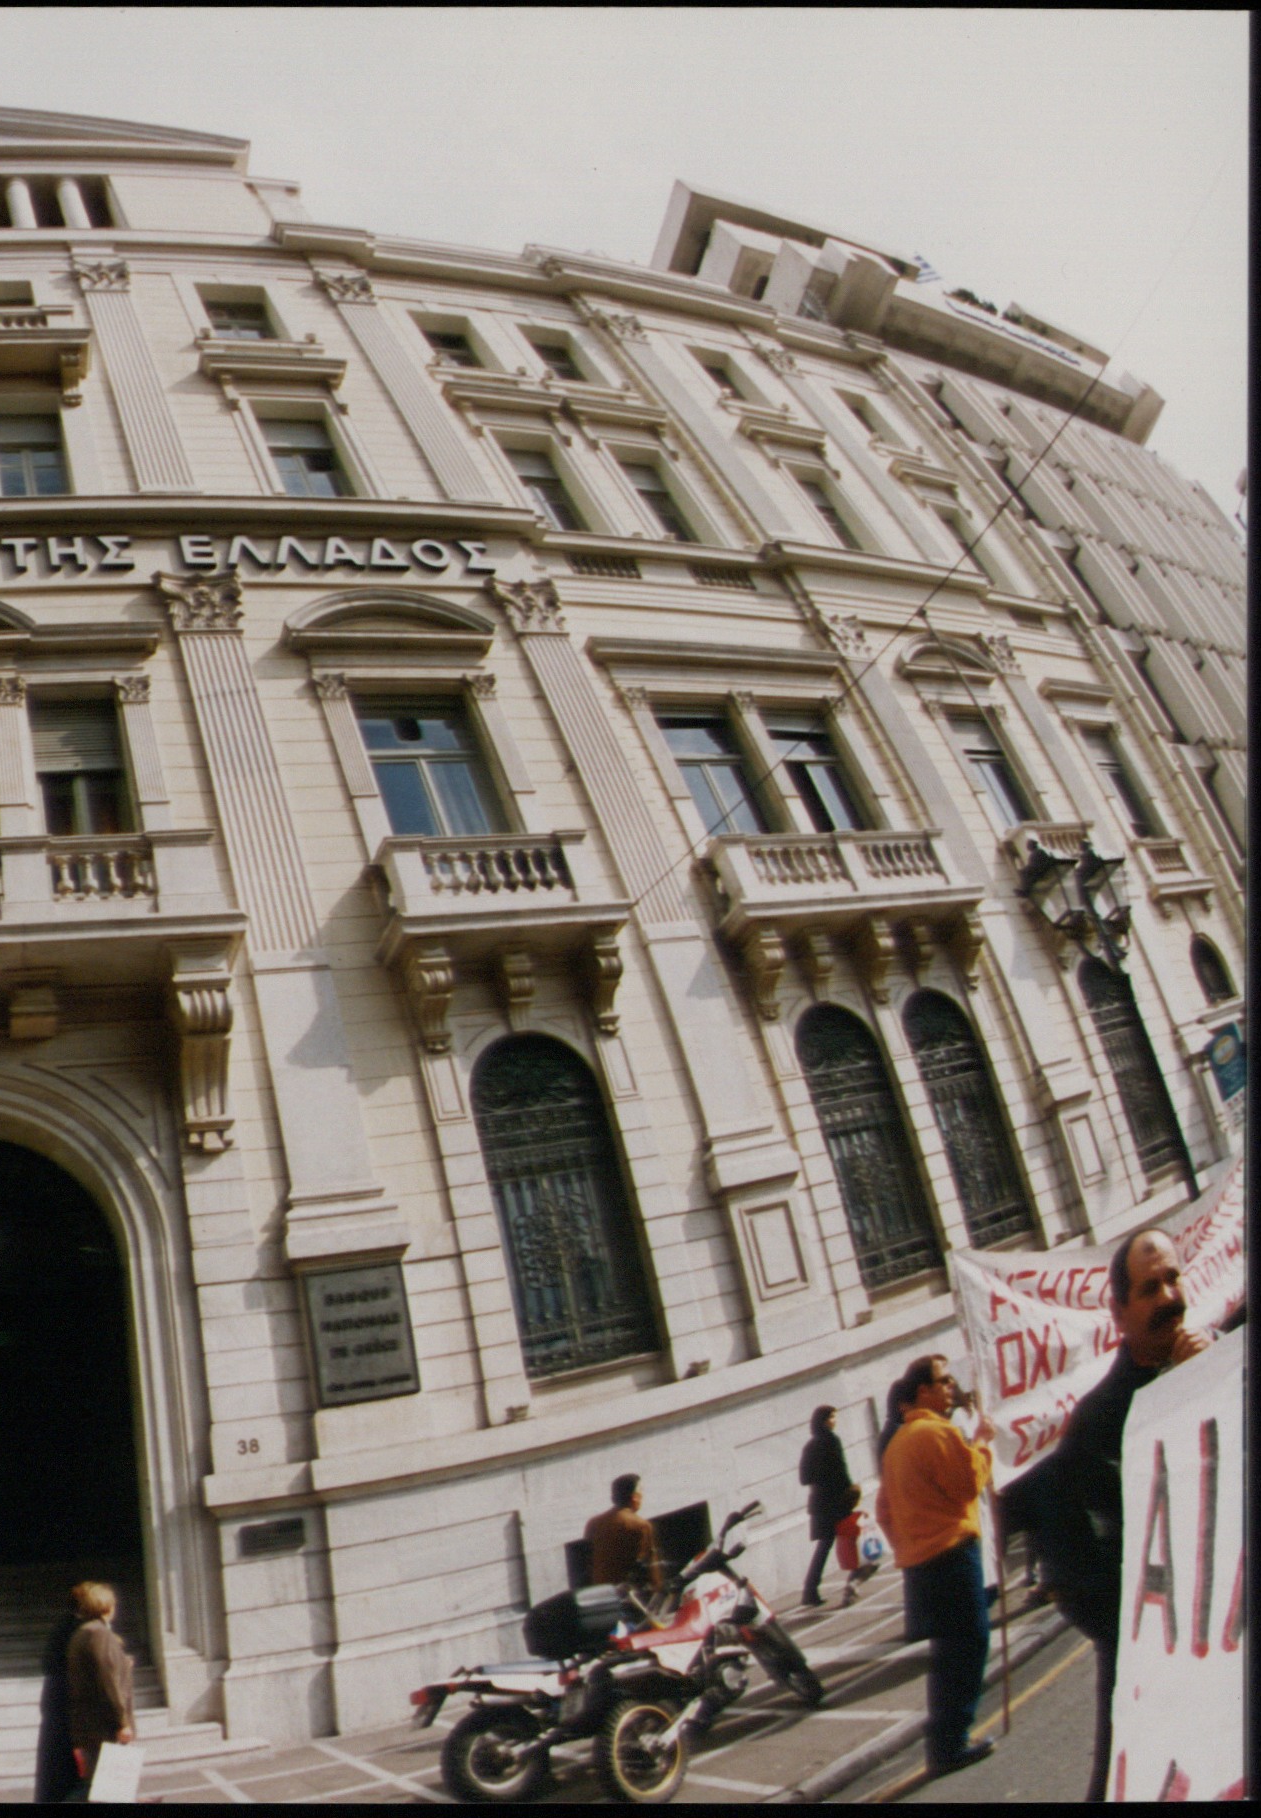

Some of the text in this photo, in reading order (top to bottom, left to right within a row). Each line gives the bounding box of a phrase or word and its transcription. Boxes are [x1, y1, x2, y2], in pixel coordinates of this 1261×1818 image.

[1, 535, 136, 575] ΤΗΣ
[178, 534, 496, 575] ΕΛΛΑΔΟΣ
[995, 1317, 1067, 1399] ΟΧΙ
[237, 1438, 260, 1455] 38
